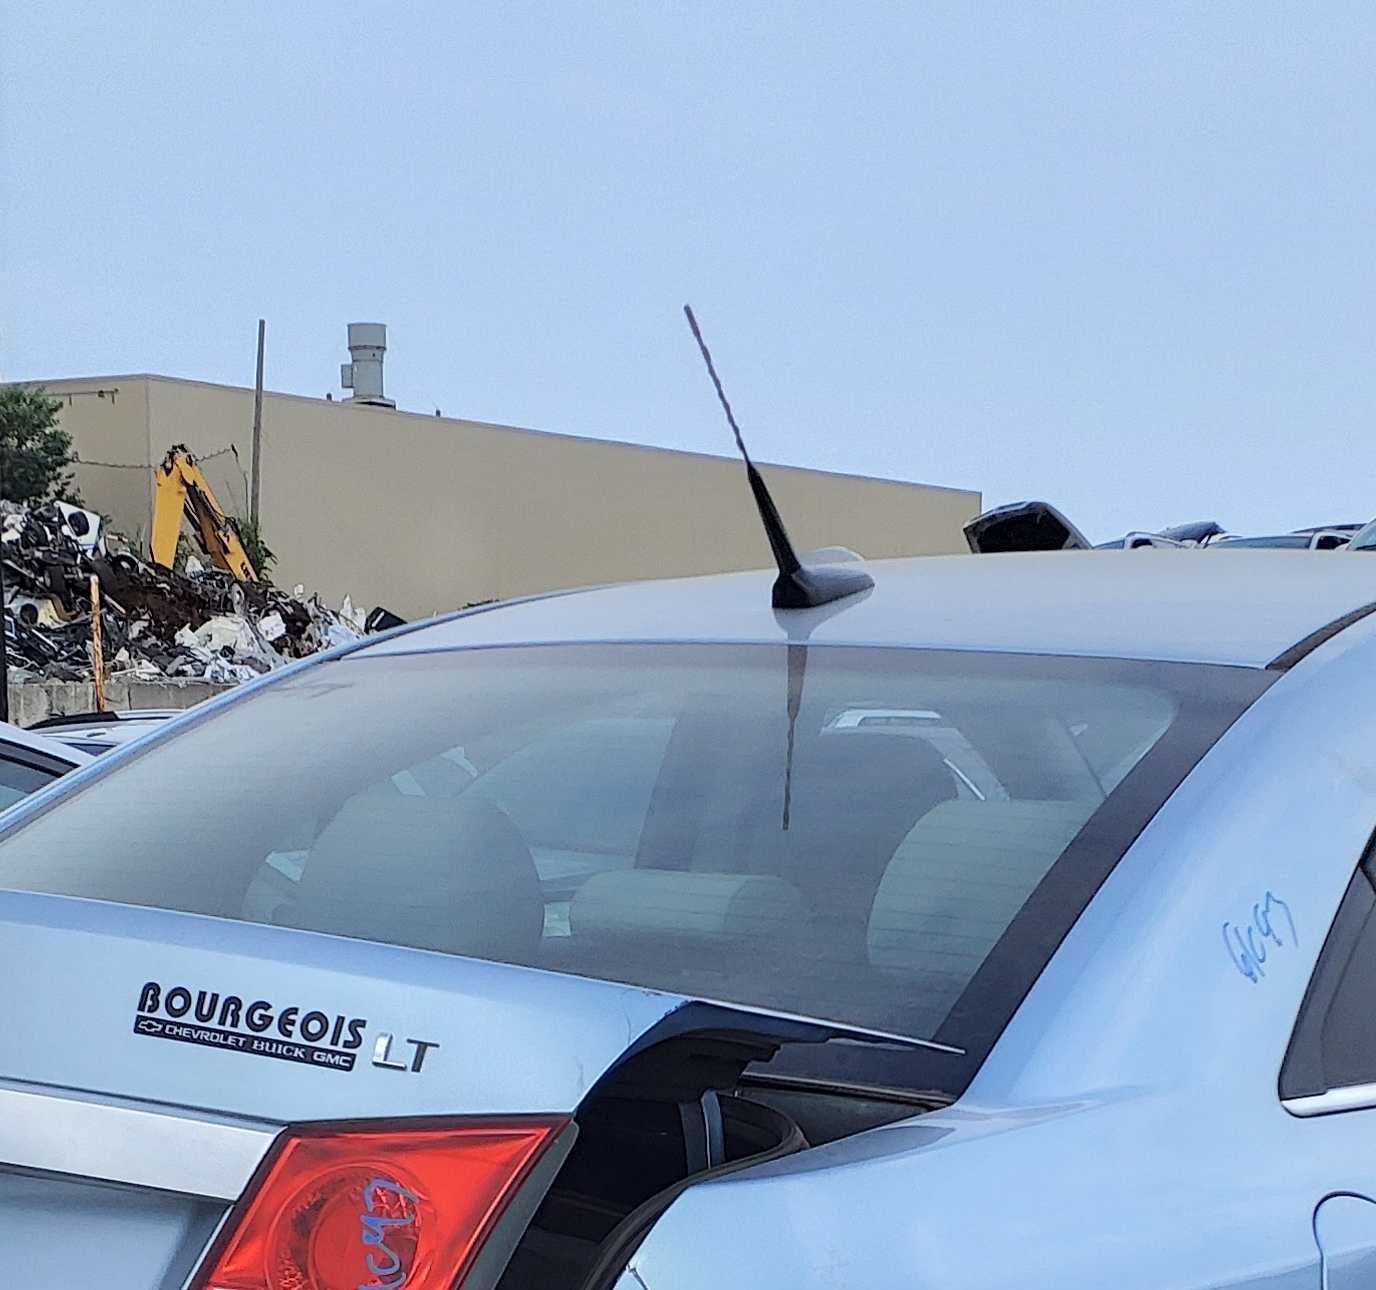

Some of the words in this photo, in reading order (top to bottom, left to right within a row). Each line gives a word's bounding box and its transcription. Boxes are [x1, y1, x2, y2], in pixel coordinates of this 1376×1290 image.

[137, 981, 367, 1049] BOURGEOIS
[164, 1025, 247, 1048] CHEVROLET
[252, 1039, 307, 1060] BUICK
[312, 1051, 354, 1068] GMC
[371, 1032, 440, 1073] LT
